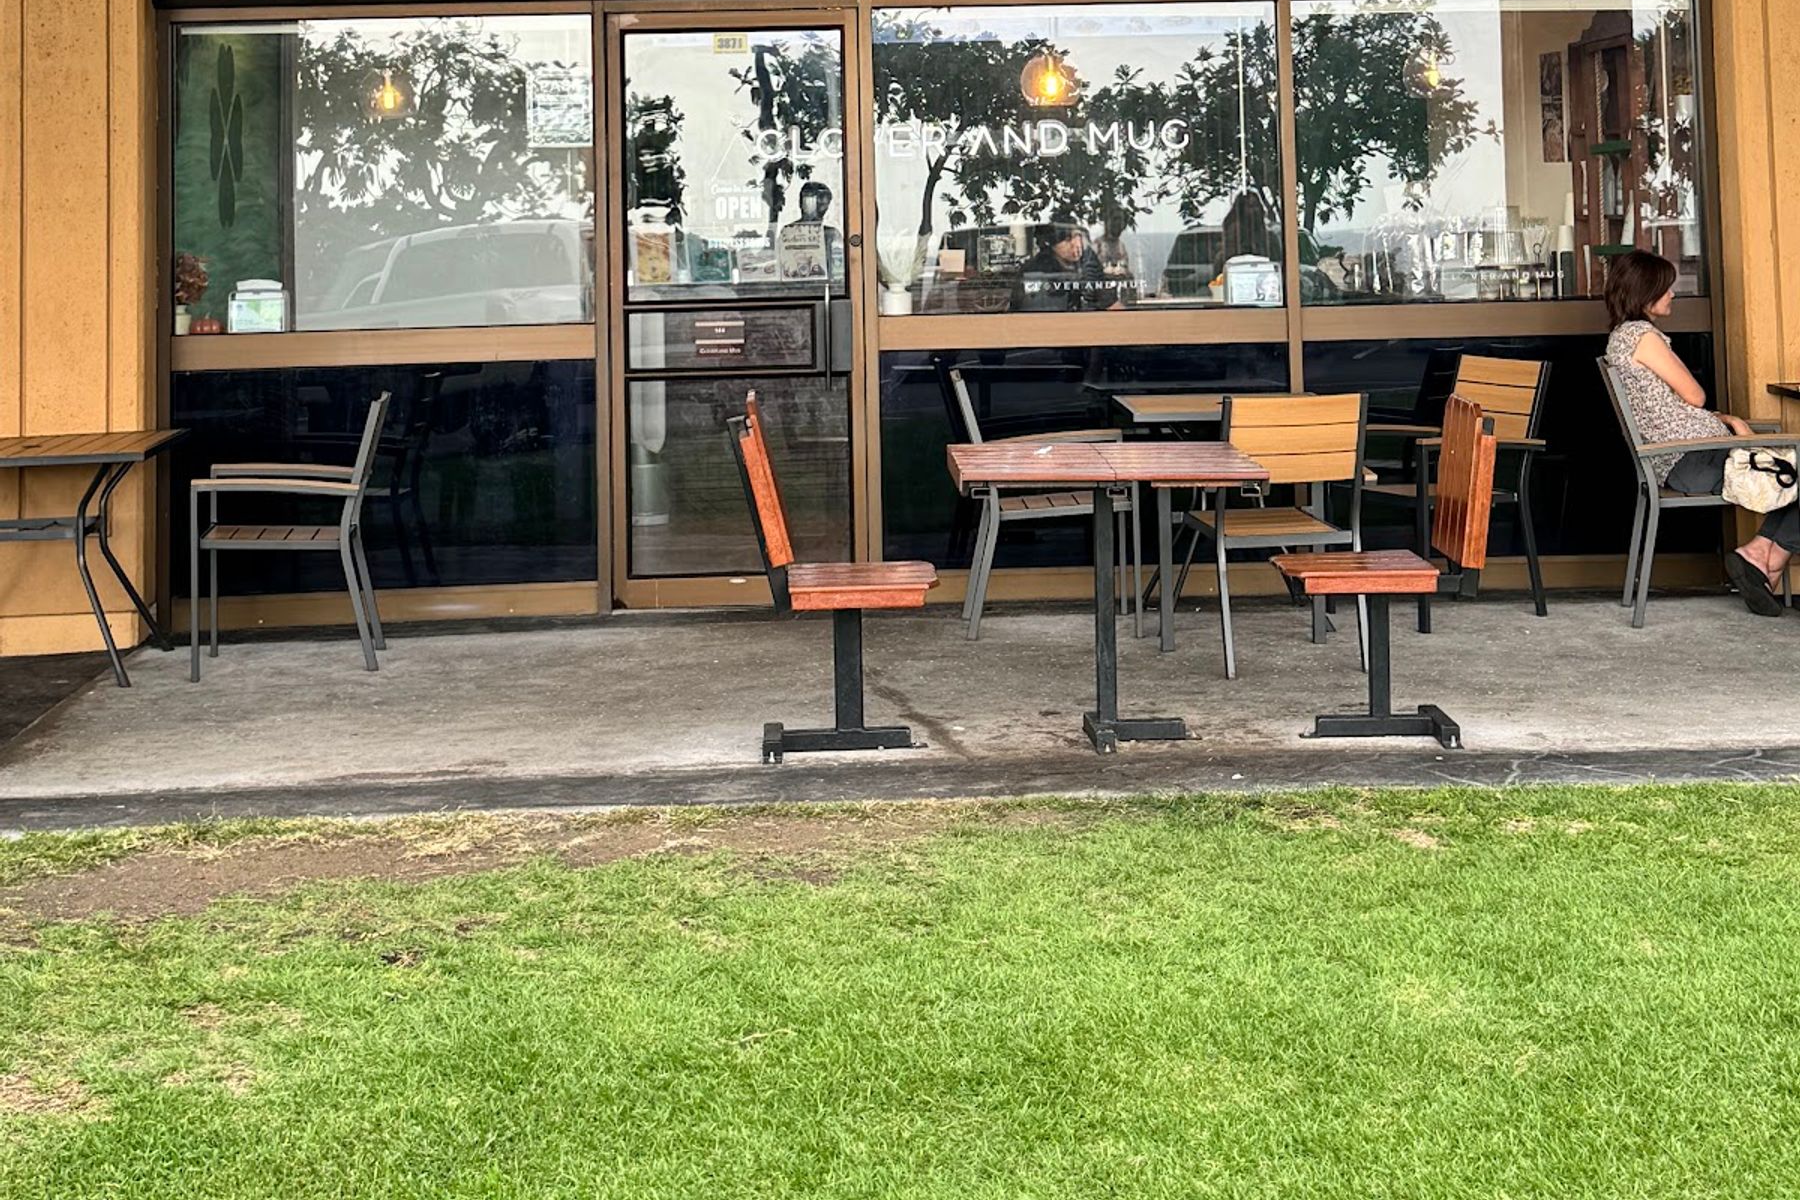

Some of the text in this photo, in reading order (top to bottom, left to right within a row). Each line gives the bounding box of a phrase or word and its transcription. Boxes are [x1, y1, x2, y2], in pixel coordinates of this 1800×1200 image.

[969, 121, 1068, 157] AND
[1088, 118, 1190, 156] MUG
[715, 196, 762, 220] OPEN
